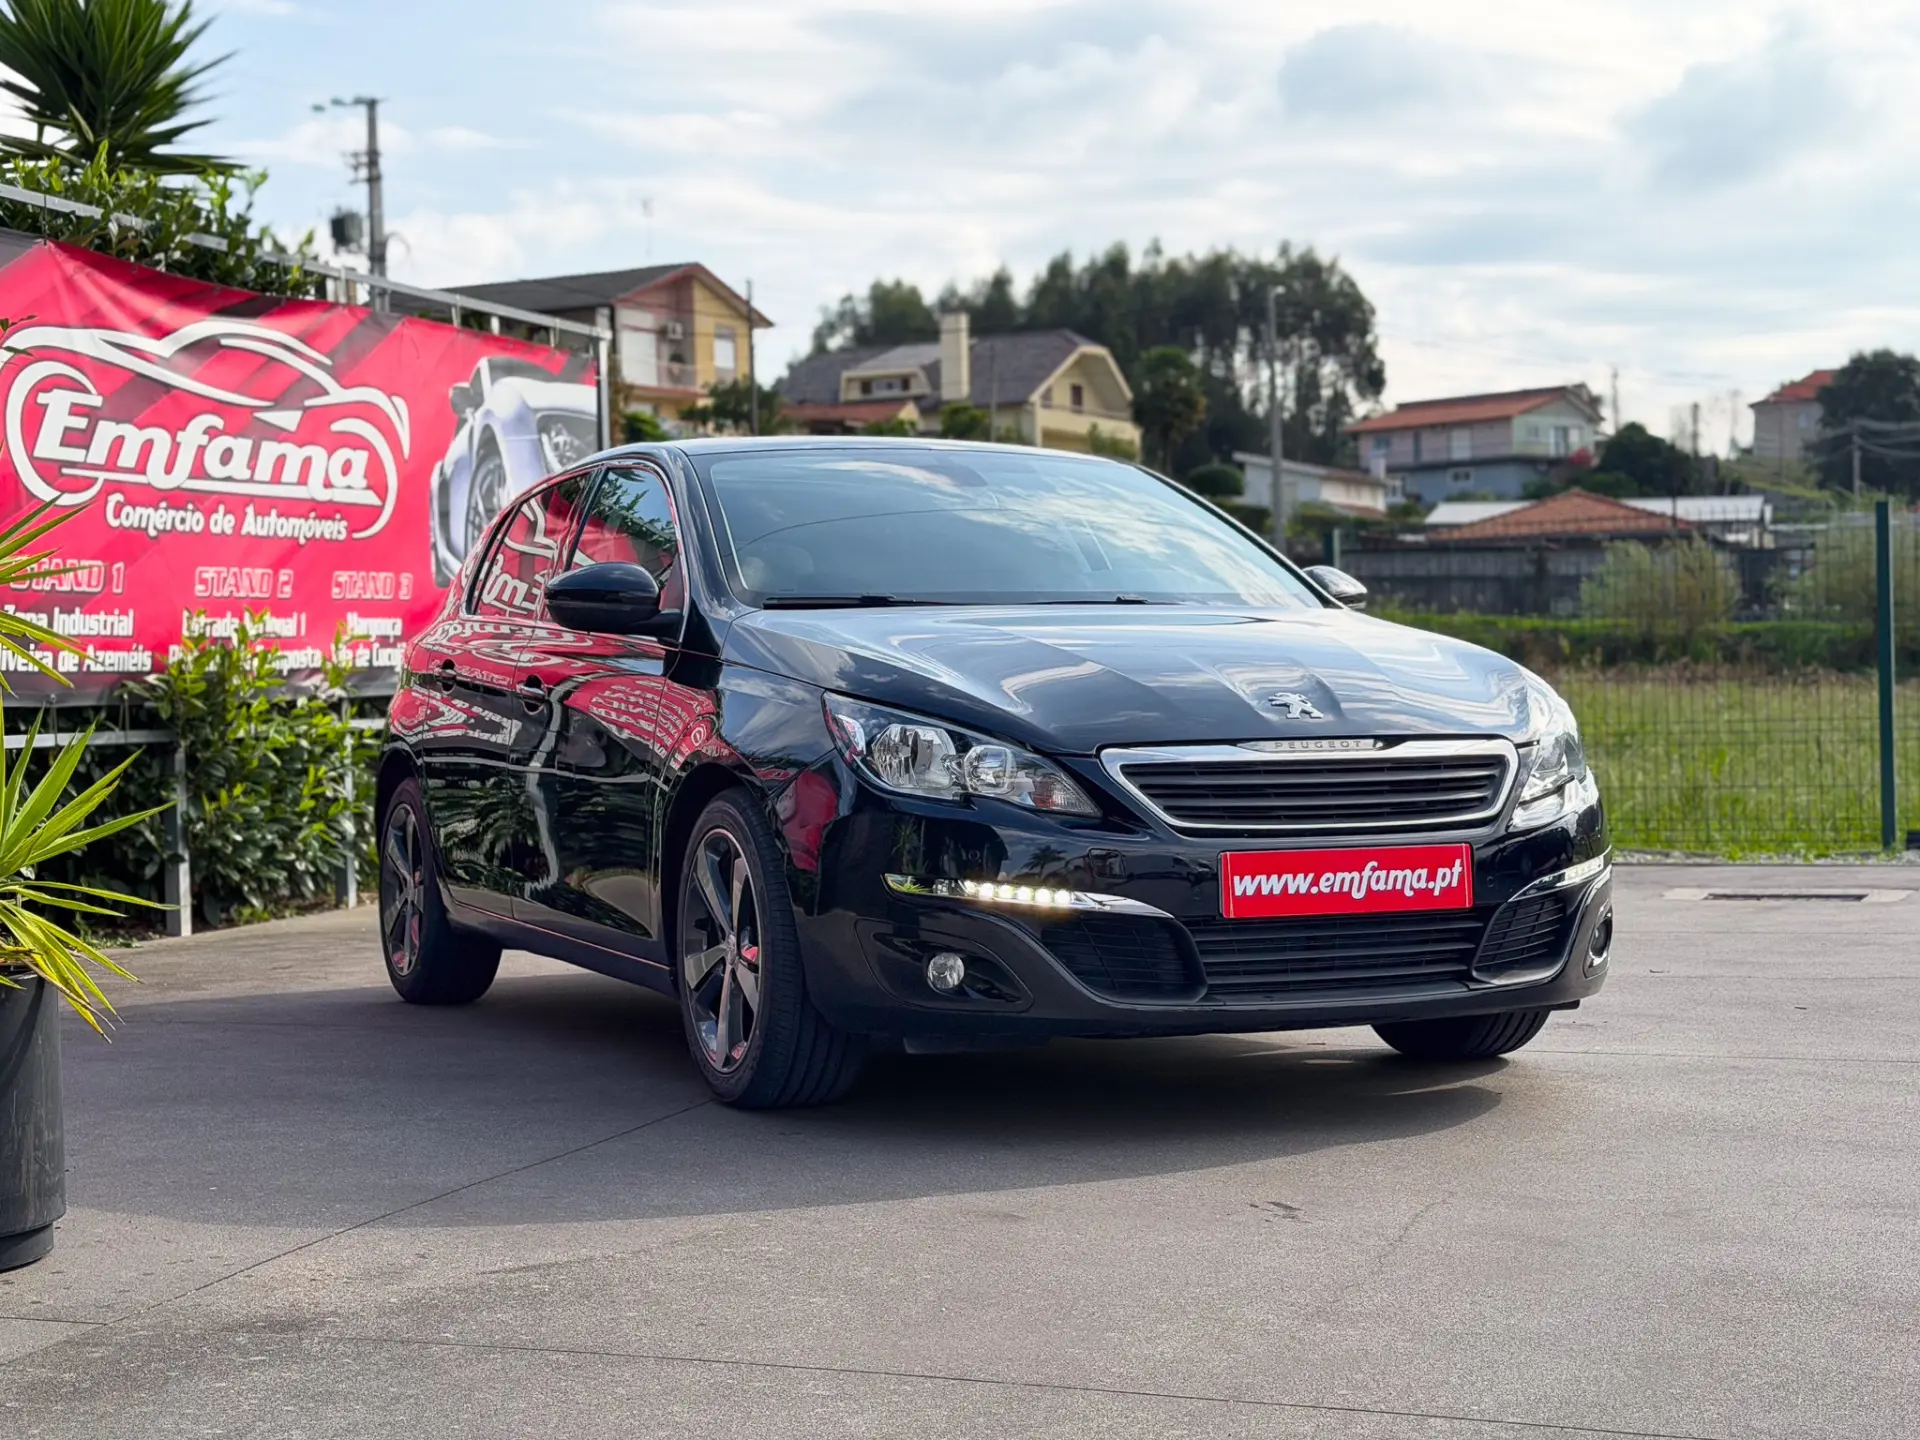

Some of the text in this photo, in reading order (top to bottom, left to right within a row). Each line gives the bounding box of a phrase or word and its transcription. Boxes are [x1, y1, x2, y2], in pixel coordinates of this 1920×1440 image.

[33, 389, 368, 501] Emfama
[106, 492, 347, 545] Comércio de Automóveis
[112, 562, 125, 594] 1
[195, 566, 294, 599] STAND 2
[332, 571, 413, 600] STAND 3
[52, 606, 134, 637] Industrial
[0, 643, 53, 672] iveira
[82, 643, 153, 673] Azeméis
[1274, 739, 1362, 750] PEUGEOT
[1233, 858, 1464, 901] www.emfama.pt
